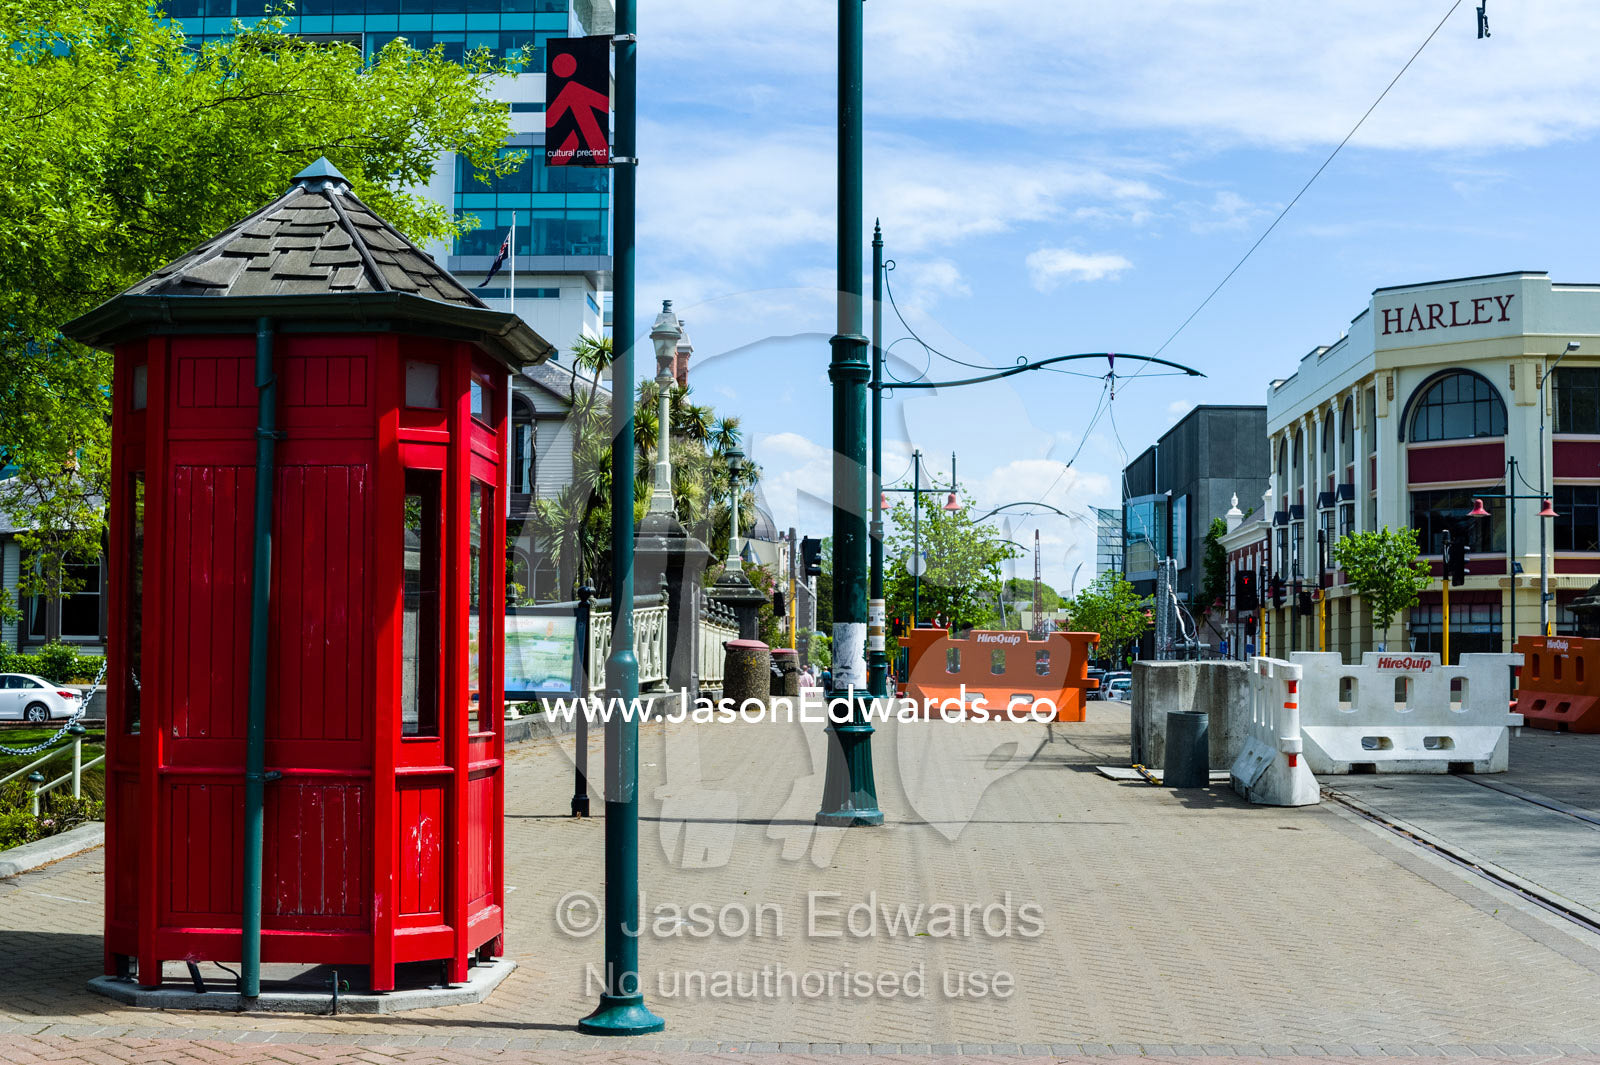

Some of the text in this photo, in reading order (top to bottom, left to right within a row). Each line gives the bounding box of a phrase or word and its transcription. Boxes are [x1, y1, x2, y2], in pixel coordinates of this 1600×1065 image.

[547, 148, 607, 158] cultural precinct
[1381, 294, 1515, 336] HARLEY
[976, 633, 1021, 646] HireQuip
[1377, 656, 1432, 672] HireQuip
